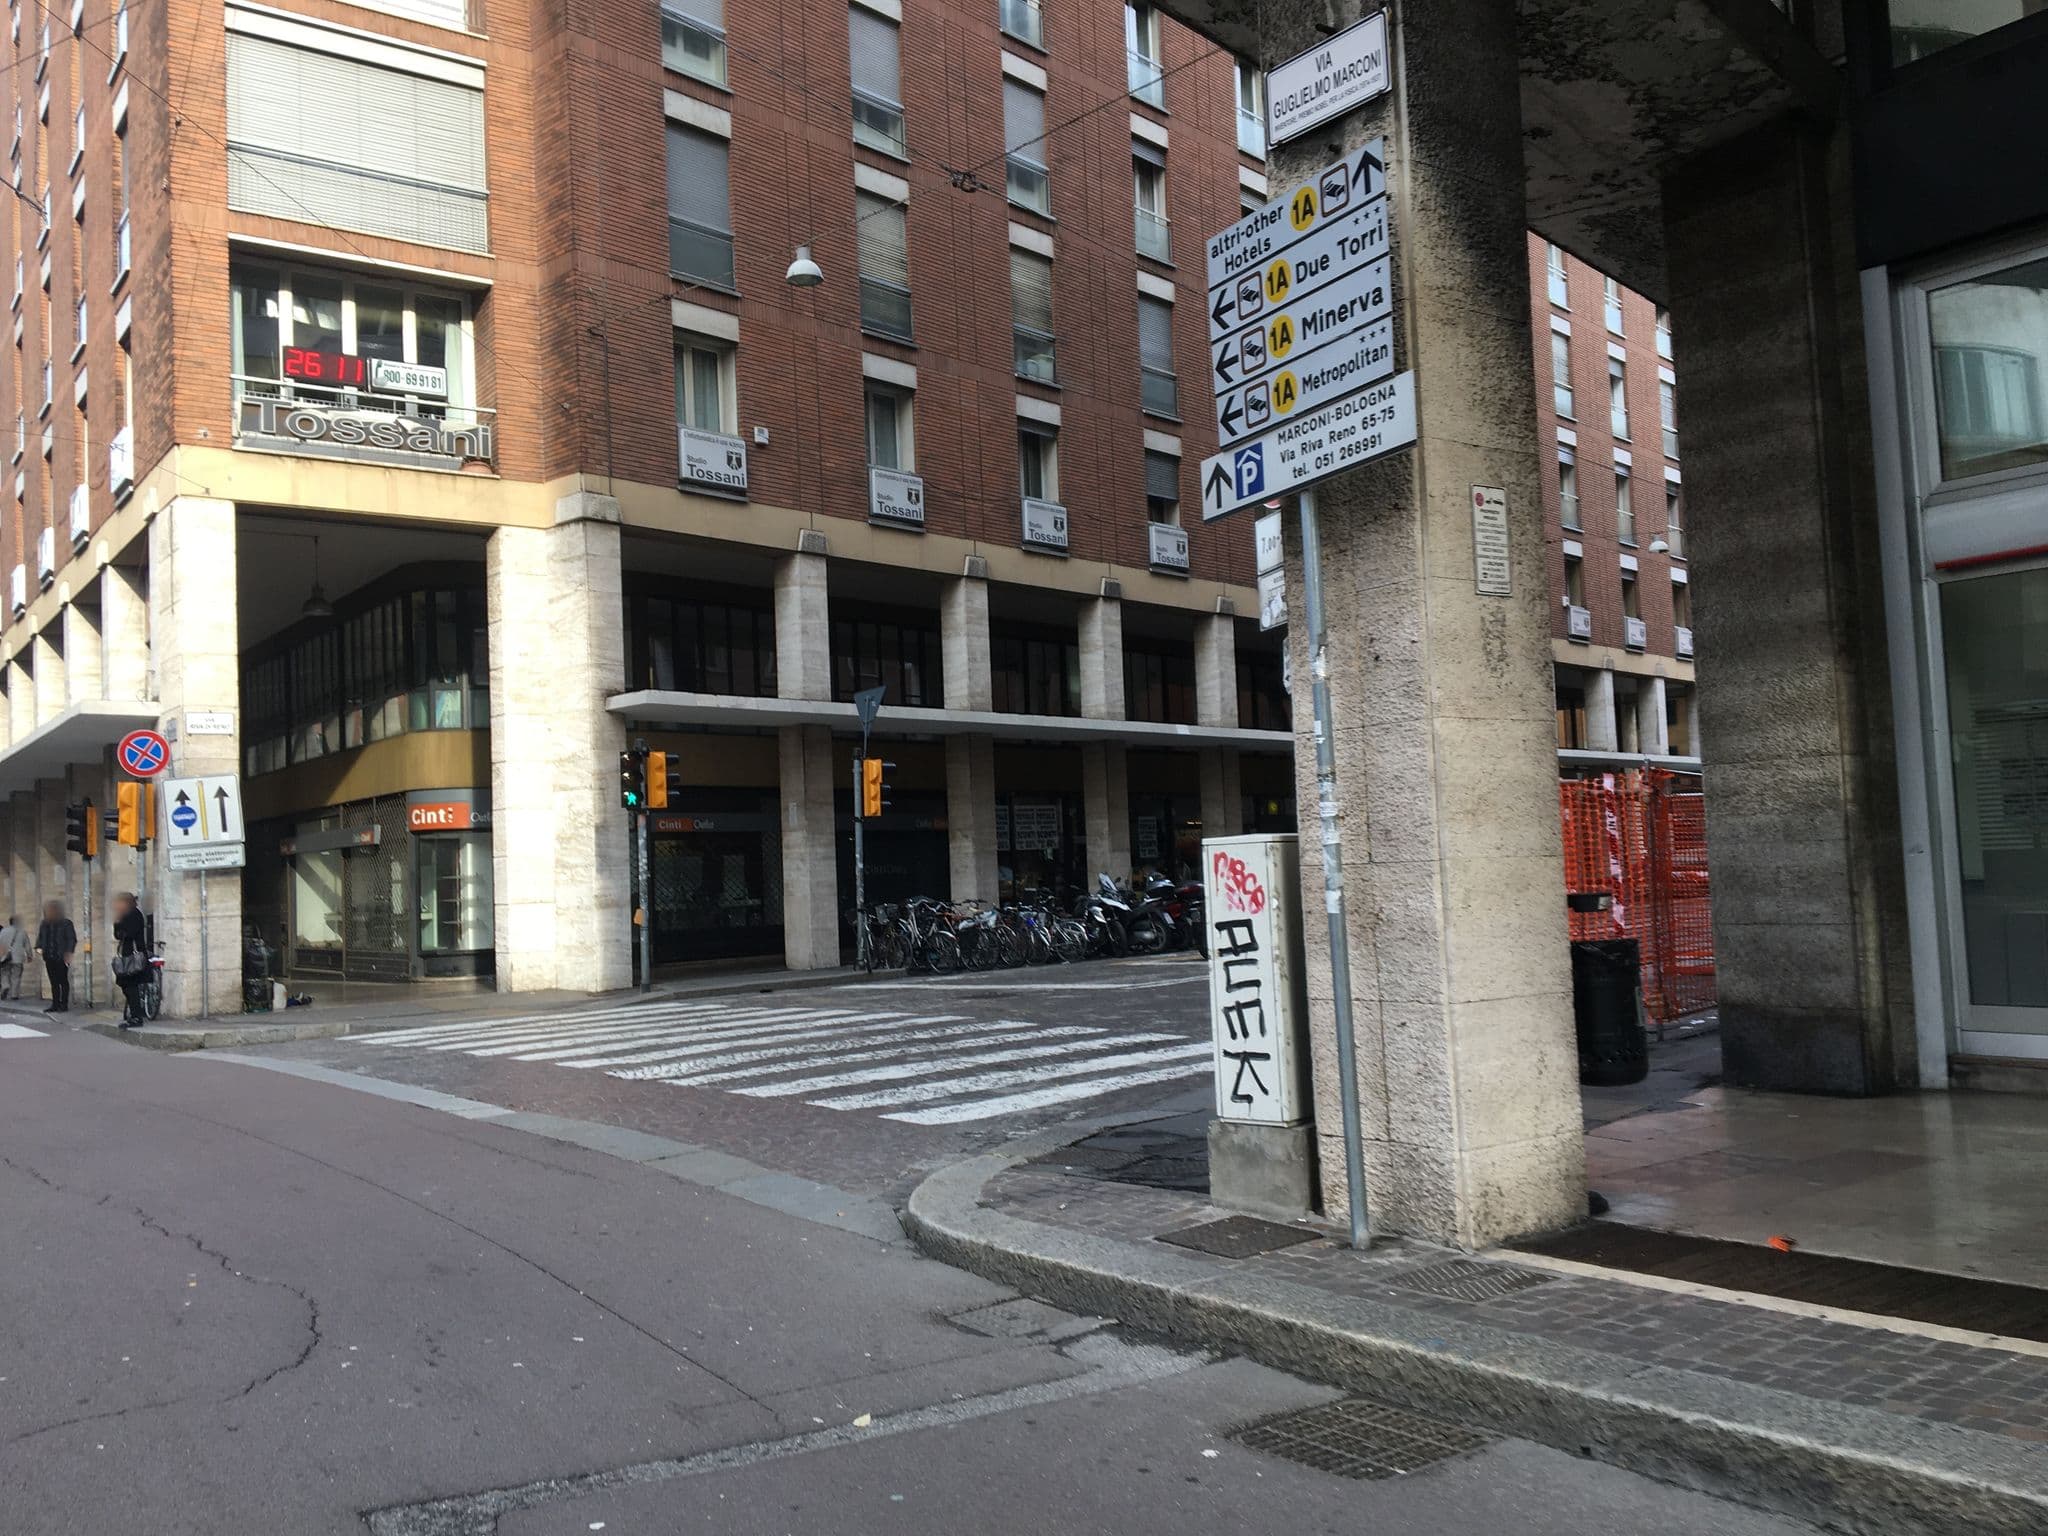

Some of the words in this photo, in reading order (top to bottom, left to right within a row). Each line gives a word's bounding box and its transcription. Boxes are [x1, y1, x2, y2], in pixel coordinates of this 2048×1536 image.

[1273, 76, 1331, 119] GUGLIELMO
[1333, 49, 1382, 89] MARCONI
[1315, 51, 1333, 73] VIA
[1210, 205, 1284, 260] altri-other
[1292, 193, 1315, 225] 1A
[1224, 236, 1271, 274] Hotels
[1268, 271, 1289, 297] 1A
[1296, 253, 1330, 284] Due
[1337, 219, 1384, 262] Torri
[1270, 321, 1292, 351] 1A
[1302, 285, 1384, 340] Minerva
[285, 349, 321, 377] 26
[337, 357, 364, 383] 11
[1274, 378, 1295, 407] 1A
[1302, 343, 1389, 395] Metropolitan
[241, 397, 491, 459] Tossani
[1278, 384, 1396, 445] MARCONI-BOLOGNA
[1280, 447, 1295, 464] Via
[1301, 438, 1324, 458] Riva
[1329, 424, 1356, 443] Reno
[1361, 406, 1396, 431] 65-75
[687, 464, 746, 486] Tossani
[1292, 463, 1310, 479] tel.
[1315, 451, 1334, 470] 051
[1339, 432, 1382, 461] 268991
[877, 500, 922, 519] Tossani
[1029, 528, 1066, 545] Tossani
[659, 819, 682, 829] Cinti
